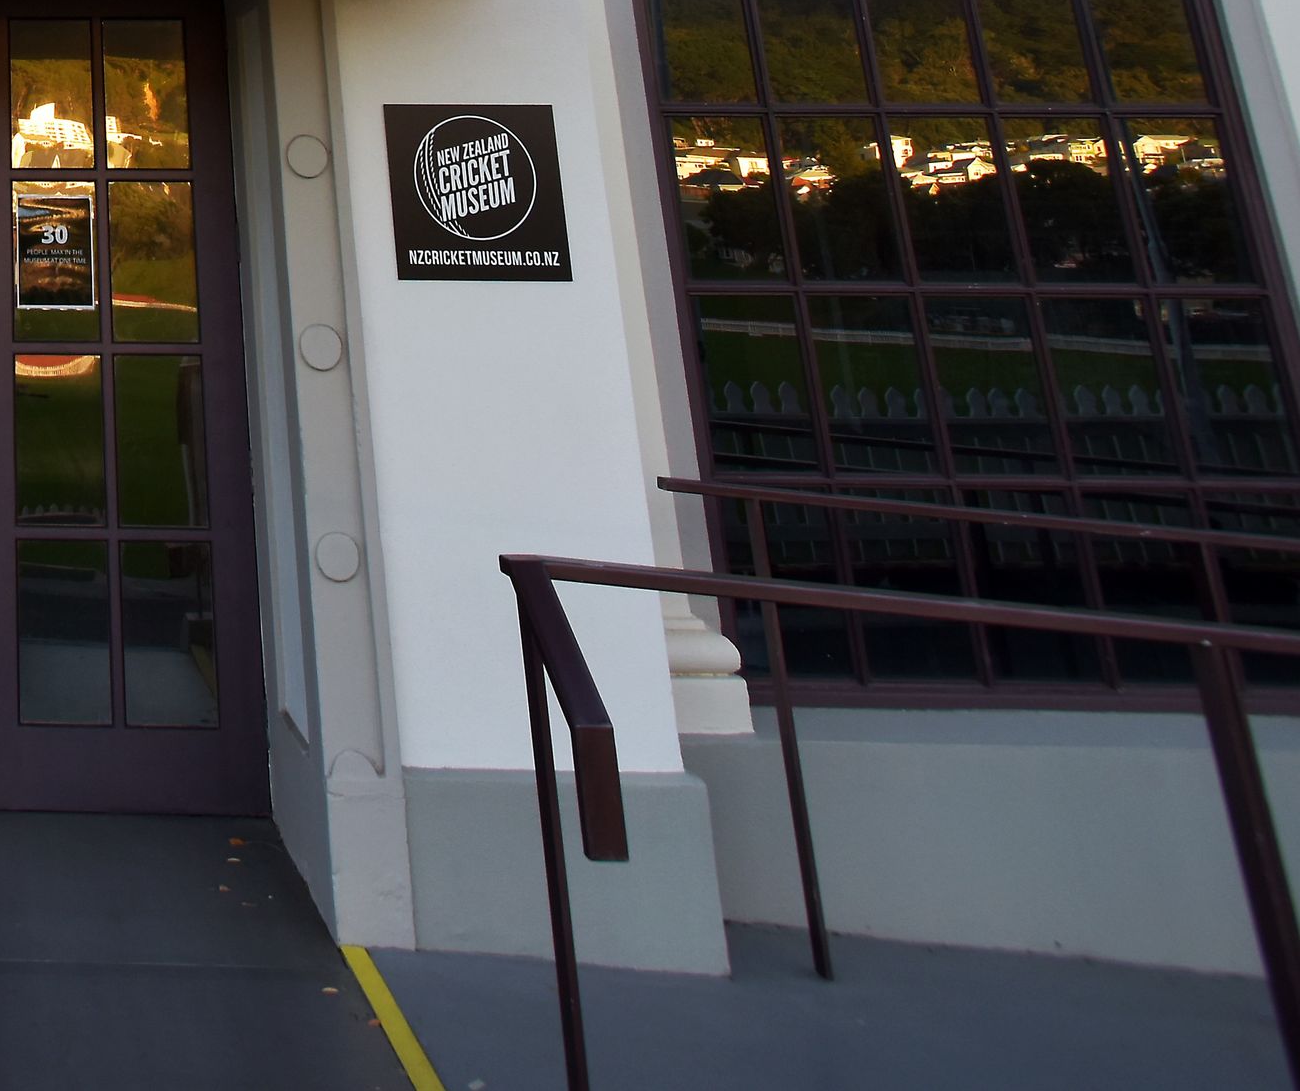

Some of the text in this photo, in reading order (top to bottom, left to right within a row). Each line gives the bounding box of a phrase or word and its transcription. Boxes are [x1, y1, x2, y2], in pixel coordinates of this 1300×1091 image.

[436, 132, 509, 167] NEW ZEALAND
[438, 149, 510, 194] CRICKET
[440, 177, 516, 222] MUSEUM
[41, 225, 68, 244] 30
[408, 249, 561, 267] NZCRICKETMUSEUM.CO.NZ
